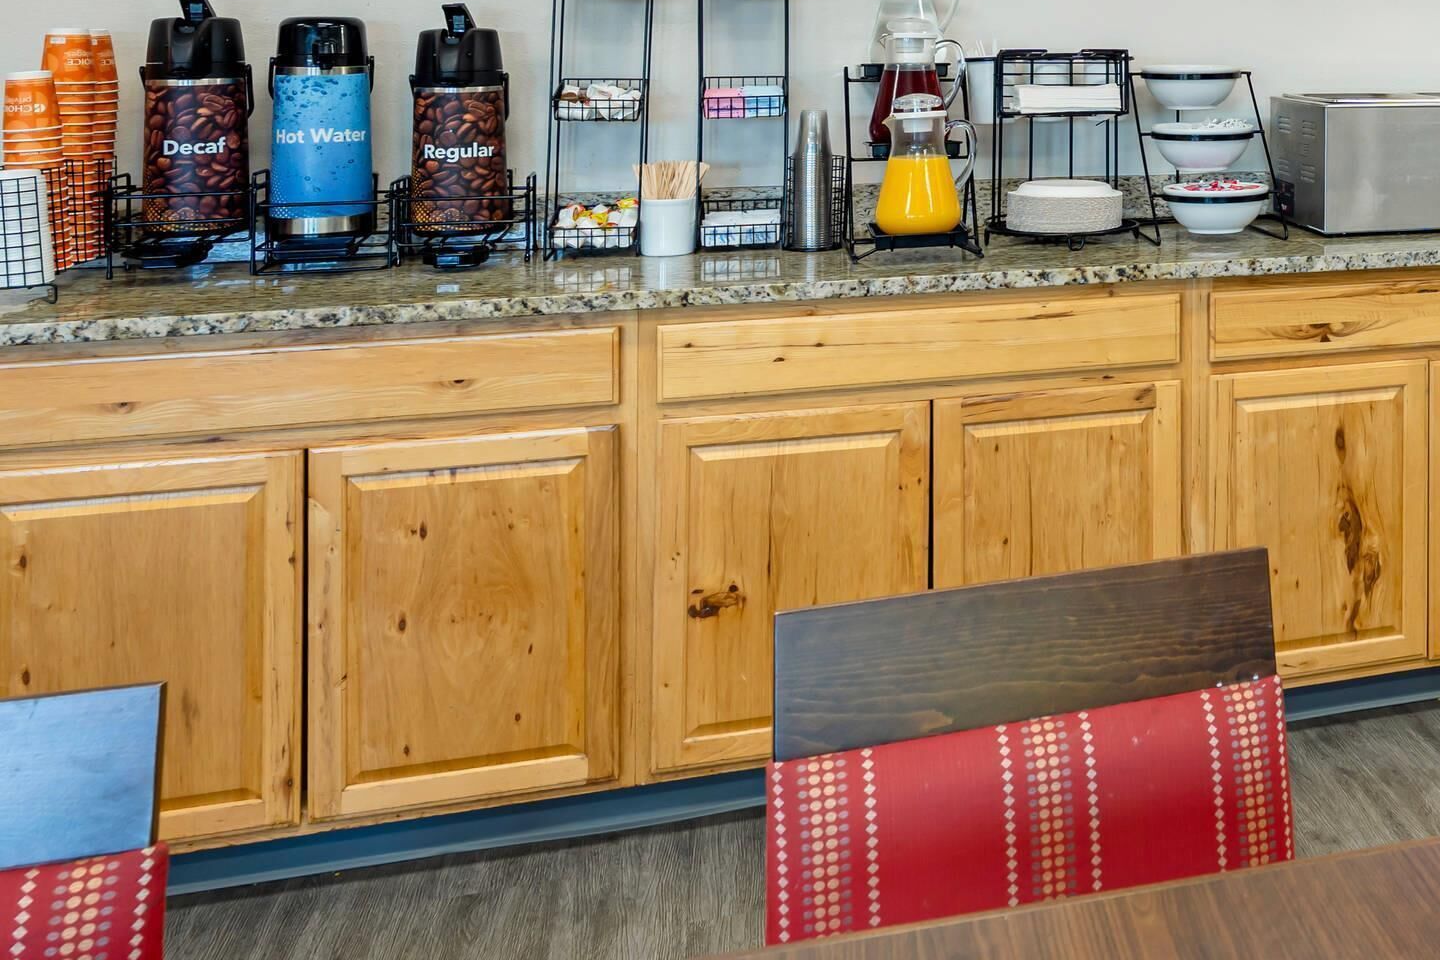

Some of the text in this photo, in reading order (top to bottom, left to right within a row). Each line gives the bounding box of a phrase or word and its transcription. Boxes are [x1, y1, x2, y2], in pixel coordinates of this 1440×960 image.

[163, 136, 226, 156] Decaf
[276, 128, 366, 144] Hot Water
[424, 142, 495, 163] Regular
